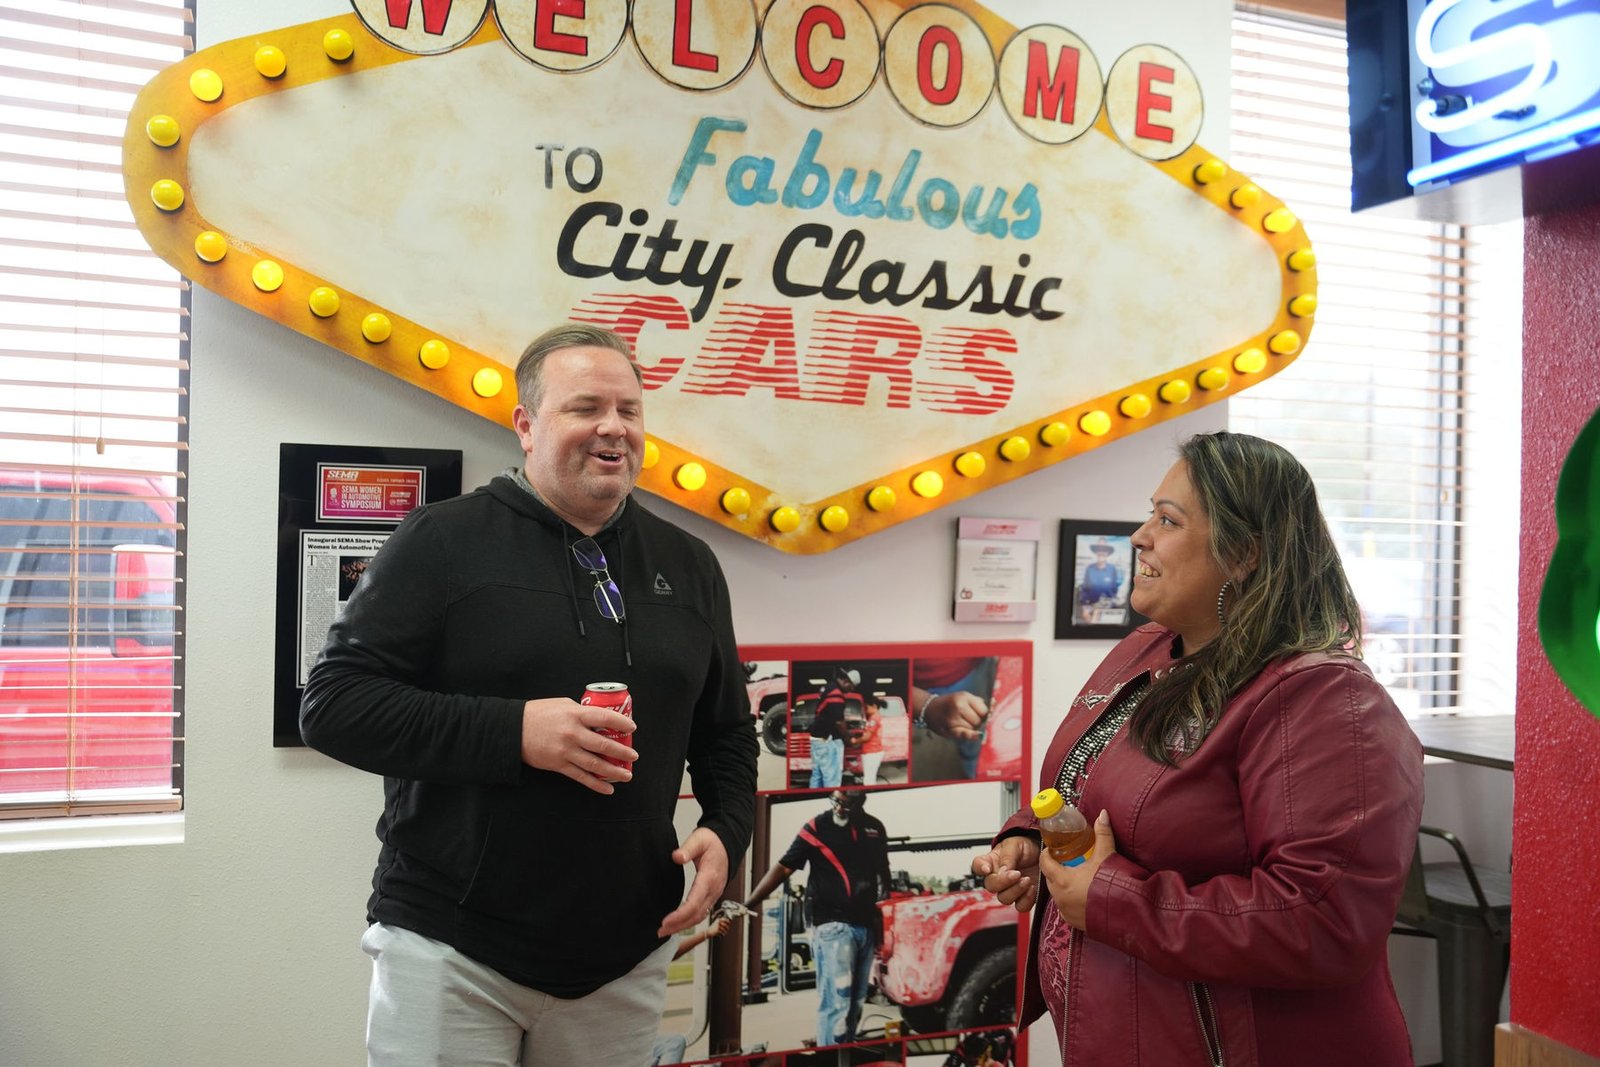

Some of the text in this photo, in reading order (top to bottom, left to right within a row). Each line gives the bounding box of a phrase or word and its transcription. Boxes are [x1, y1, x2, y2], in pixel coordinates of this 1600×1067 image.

[535, 115, 1042, 240] TO Fabulous
[772, 223, 1065, 321] Classic
[568, 293, 1018, 415] CARS
[341, 485, 382, 494] SEMA WOMEN
[341, 499, 382, 509] SYMPOSIUM
[348, 493, 382, 501] AUTOMOTIVE
